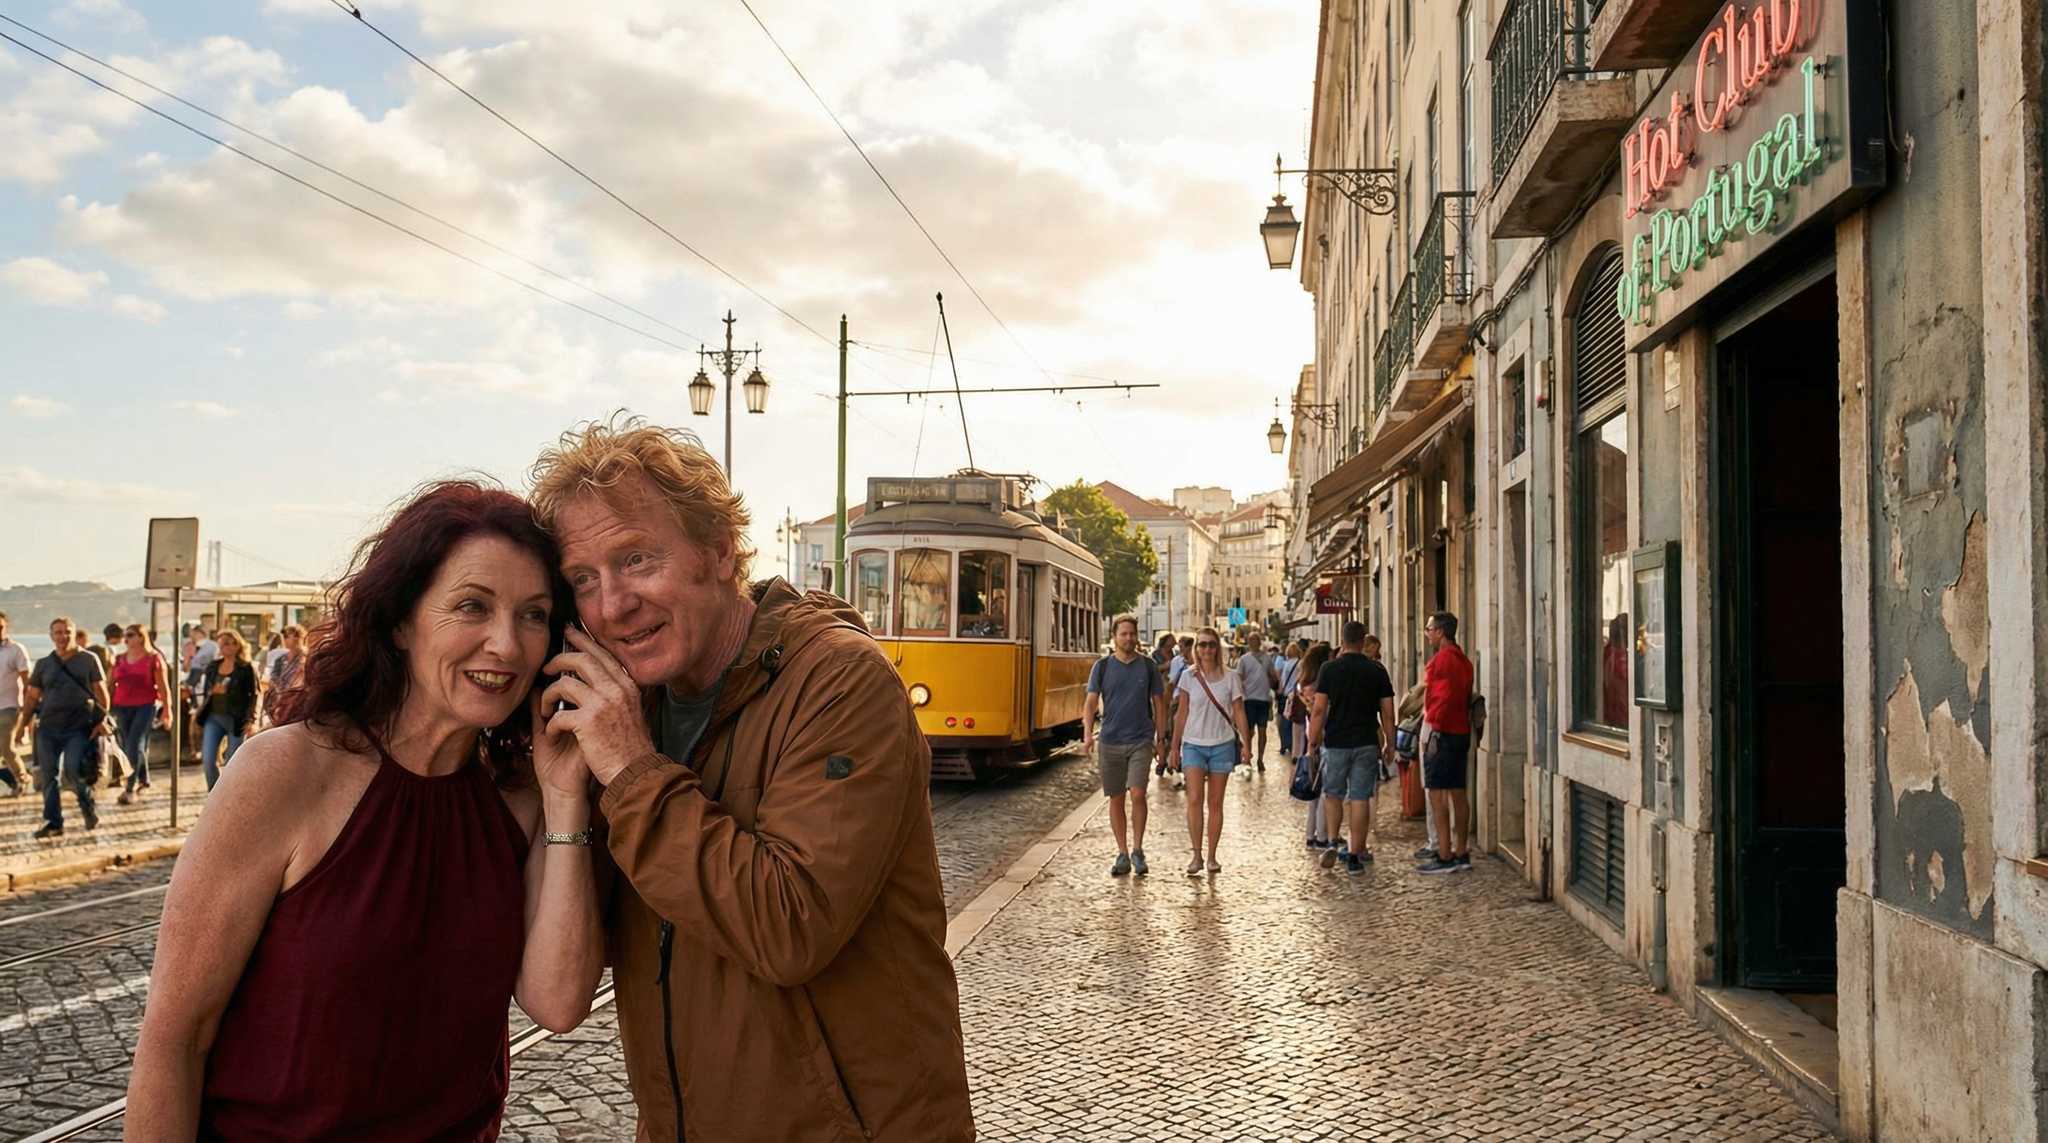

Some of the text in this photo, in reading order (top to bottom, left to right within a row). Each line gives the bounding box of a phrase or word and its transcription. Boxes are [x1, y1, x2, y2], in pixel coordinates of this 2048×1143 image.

[1617, 56, 1821, 326] of Portugal
[1625, 91, 1684, 218] Hot
